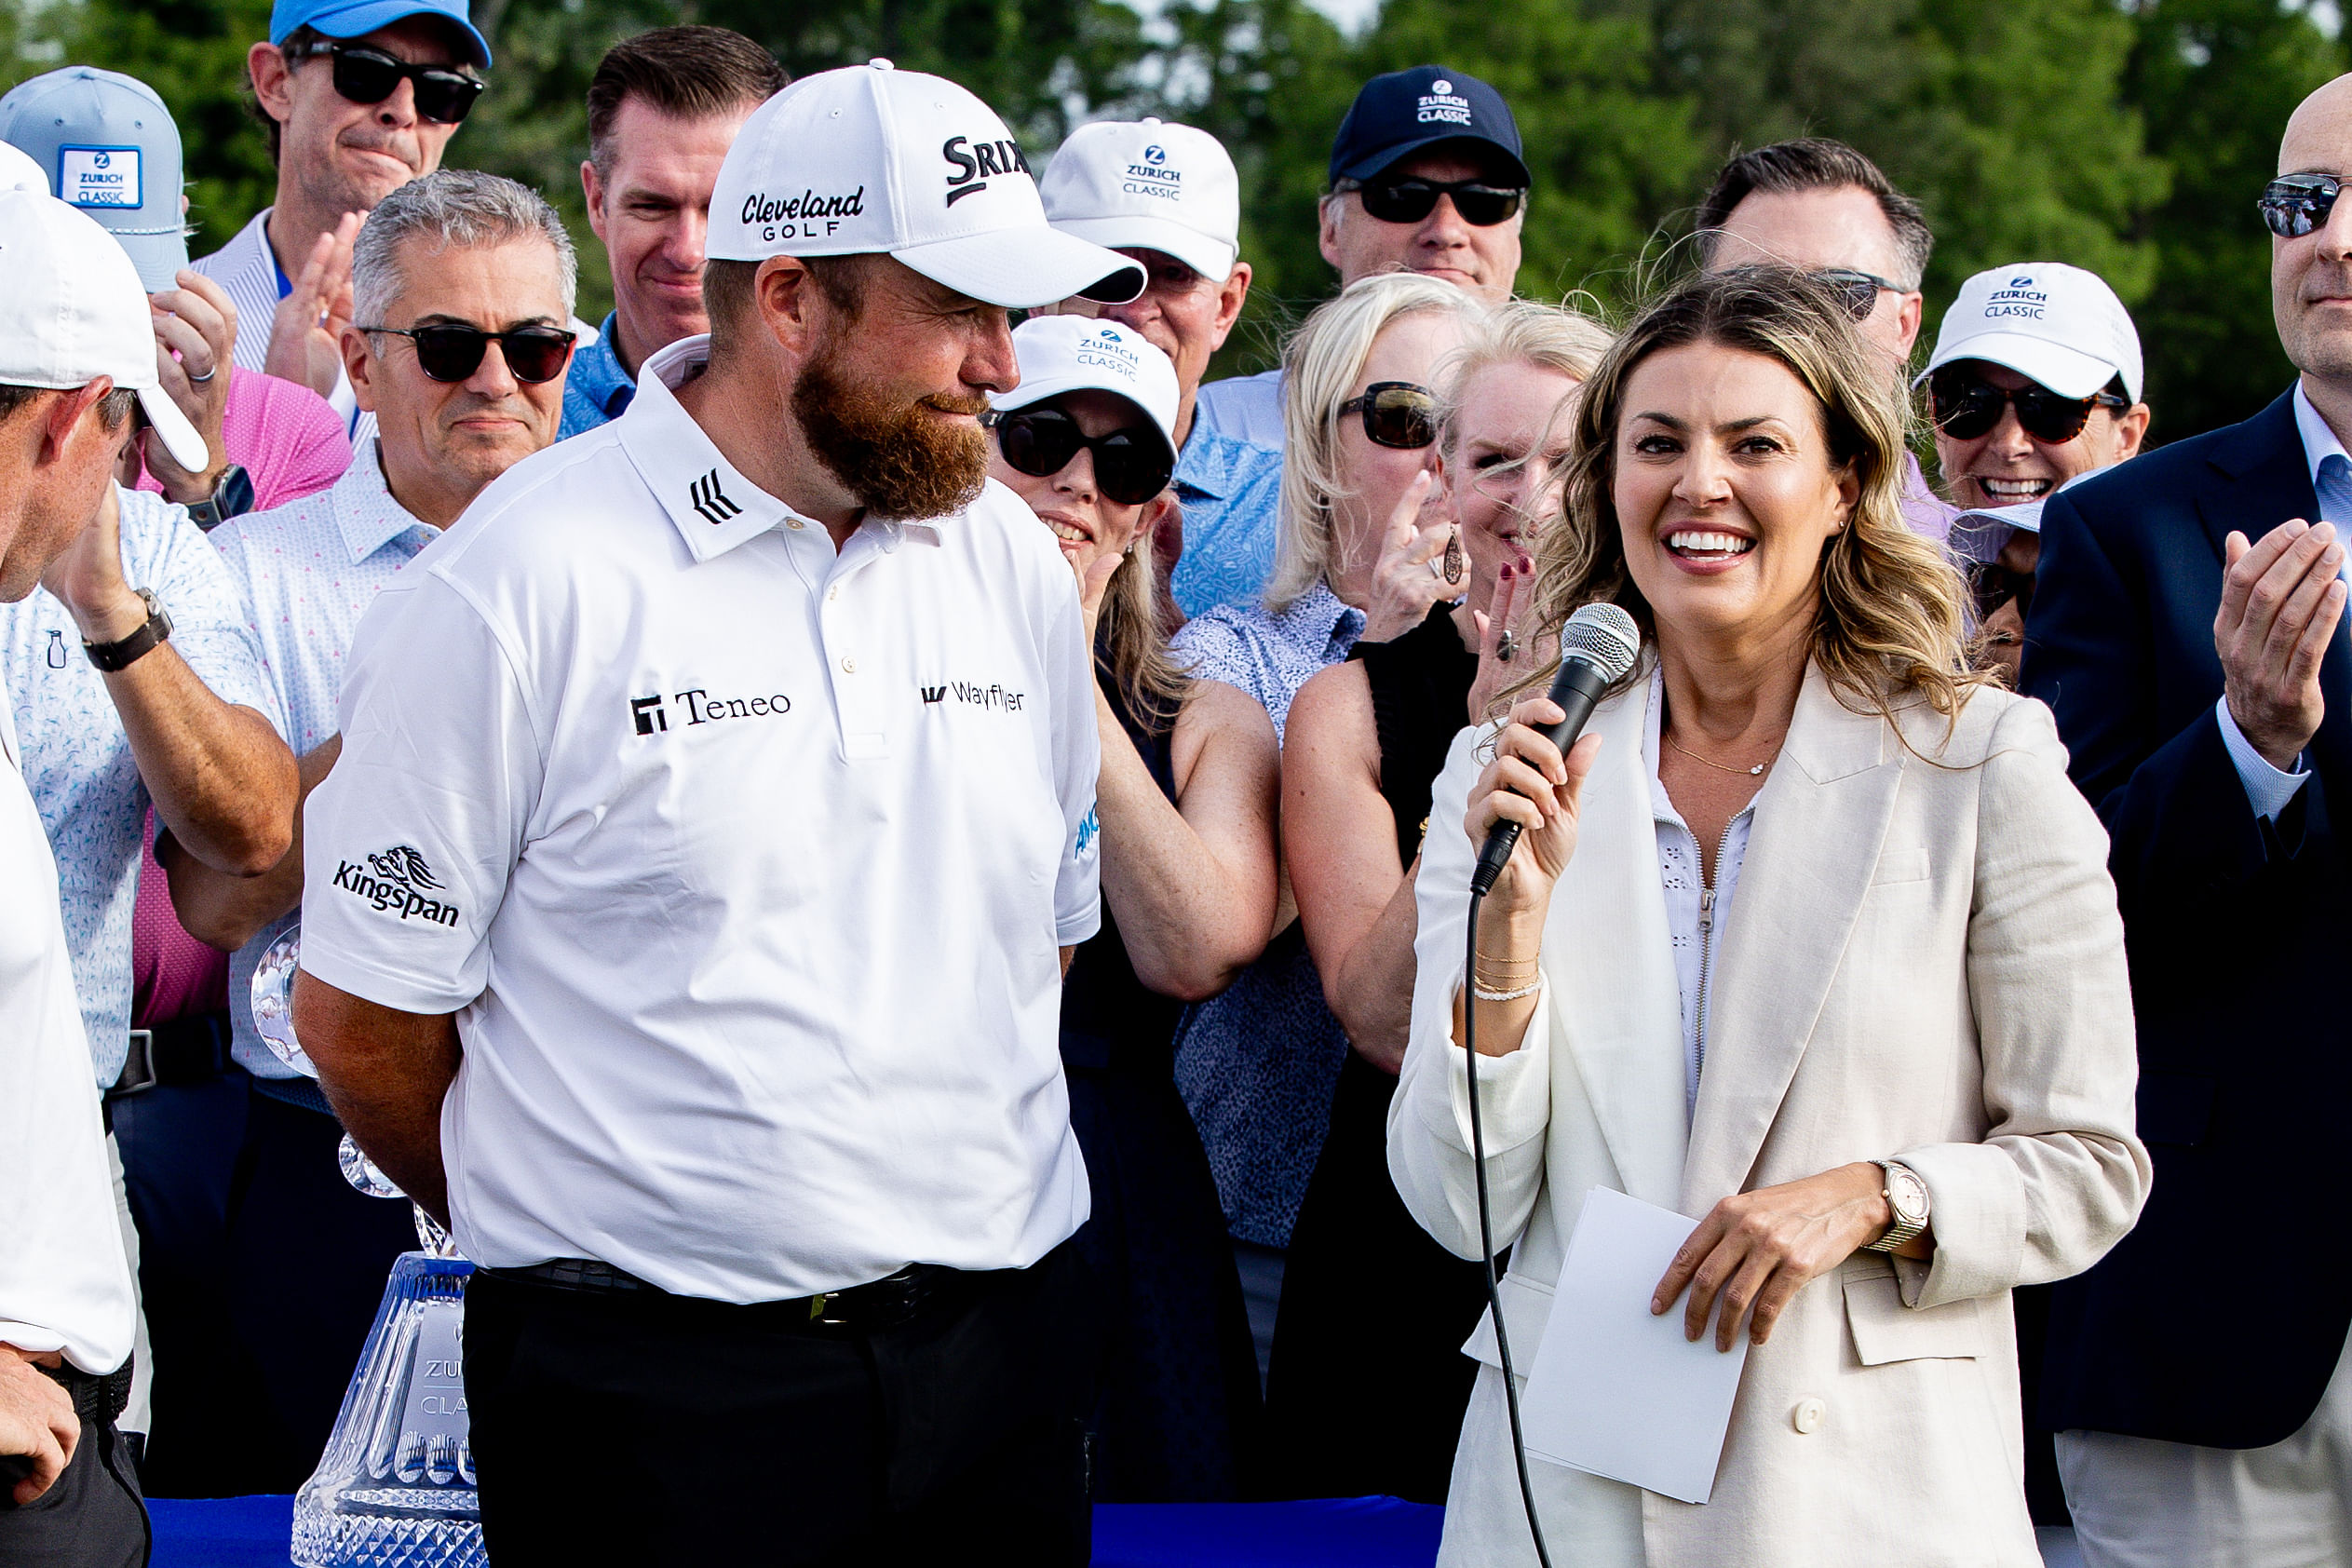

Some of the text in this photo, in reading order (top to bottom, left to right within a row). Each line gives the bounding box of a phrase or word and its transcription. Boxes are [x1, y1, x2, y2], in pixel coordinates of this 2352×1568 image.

[1418, 109, 1471, 127] CLASSIC
[943, 136, 1031, 185] SRIX
[80, 173, 123, 182] ZURICH
[1127, 165, 1181, 182] ZURICH
[78, 191, 124, 204] CLASSIC
[1123, 182, 1180, 201] CLASSIC
[742, 185, 864, 224] Cleveland
[763, 222, 840, 242] GOLF
[1989, 291, 2047, 302] ZURICH
[1984, 305, 2045, 320] CLASSIC
[1080, 339, 1139, 364] ZURICH
[1077, 355, 1136, 382] CLASSIC
[675, 689, 791, 725] Teneo
[332, 859, 459, 927] Kingspan
[424, 1359, 462, 1378] ZU
[420, 1396, 467, 1415] CLA
